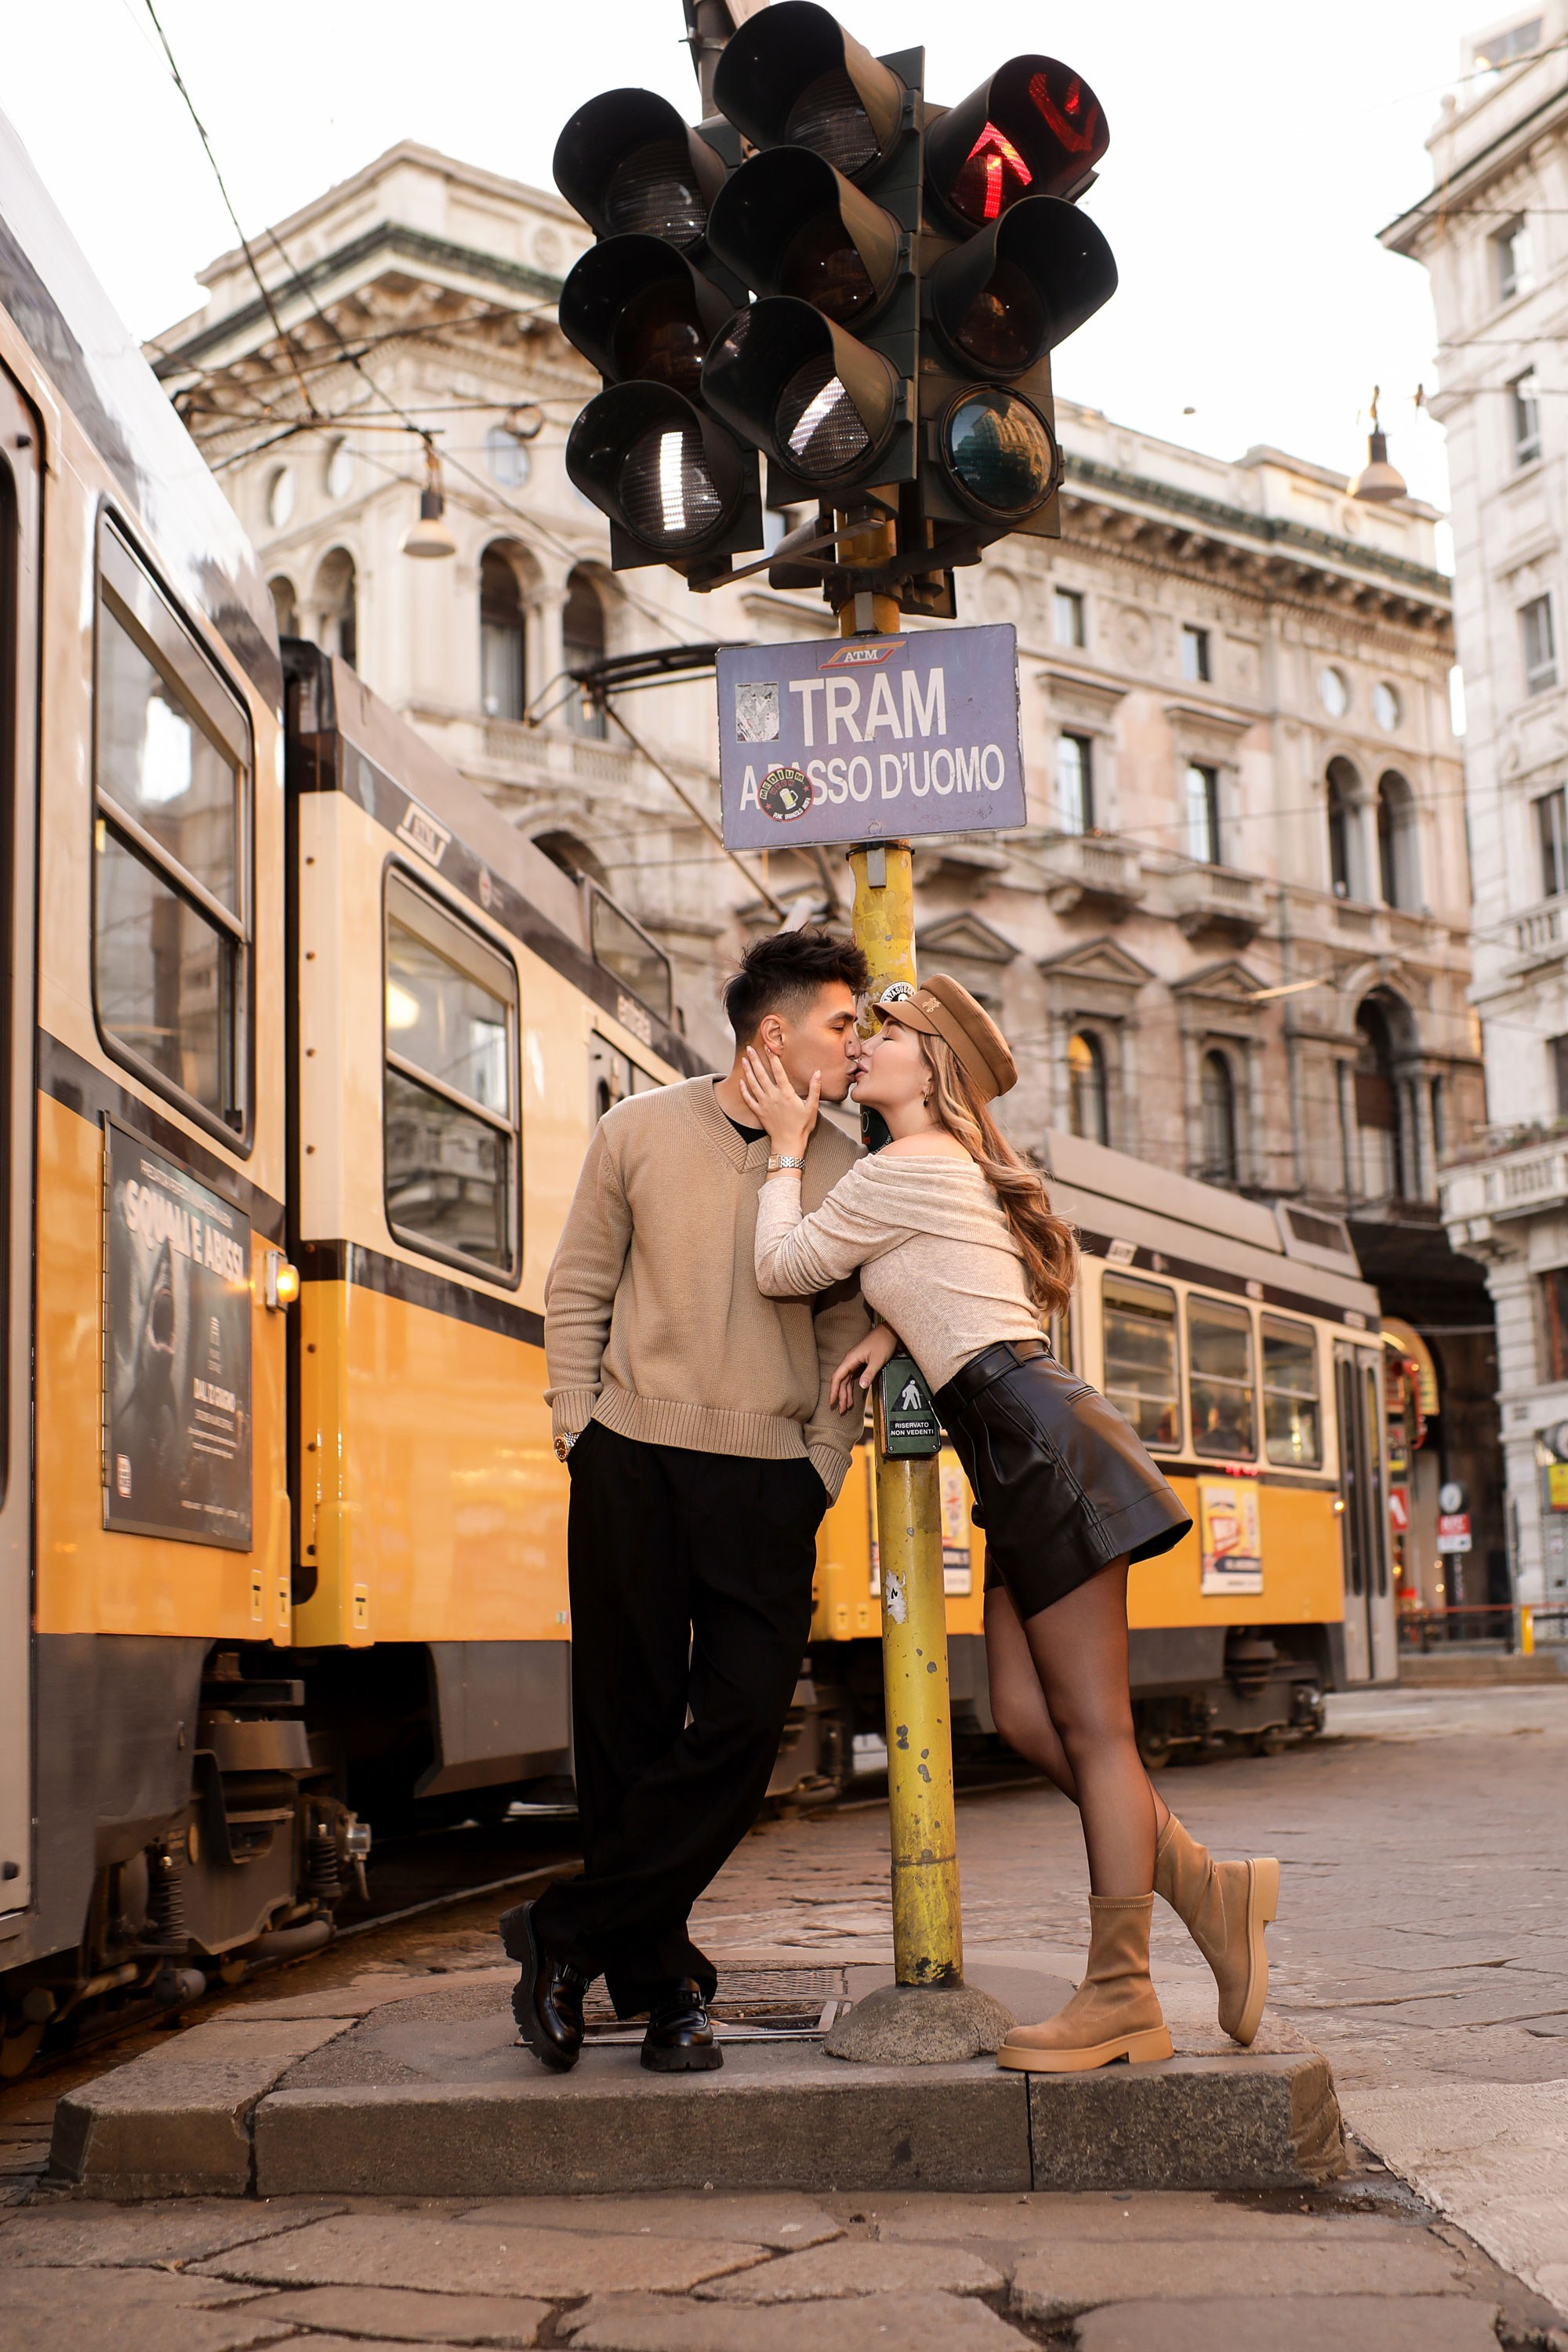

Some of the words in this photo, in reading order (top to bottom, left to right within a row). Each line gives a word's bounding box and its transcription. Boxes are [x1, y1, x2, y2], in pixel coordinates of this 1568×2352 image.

[844, 649, 879, 662] ATM
[789, 667, 947, 746] TRAM
[740, 765, 760, 811] A
[767, 755, 873, 806] SSO
[880, 744, 1005, 800] D'UOMO
[760, 769, 804, 800] MEDIUM
